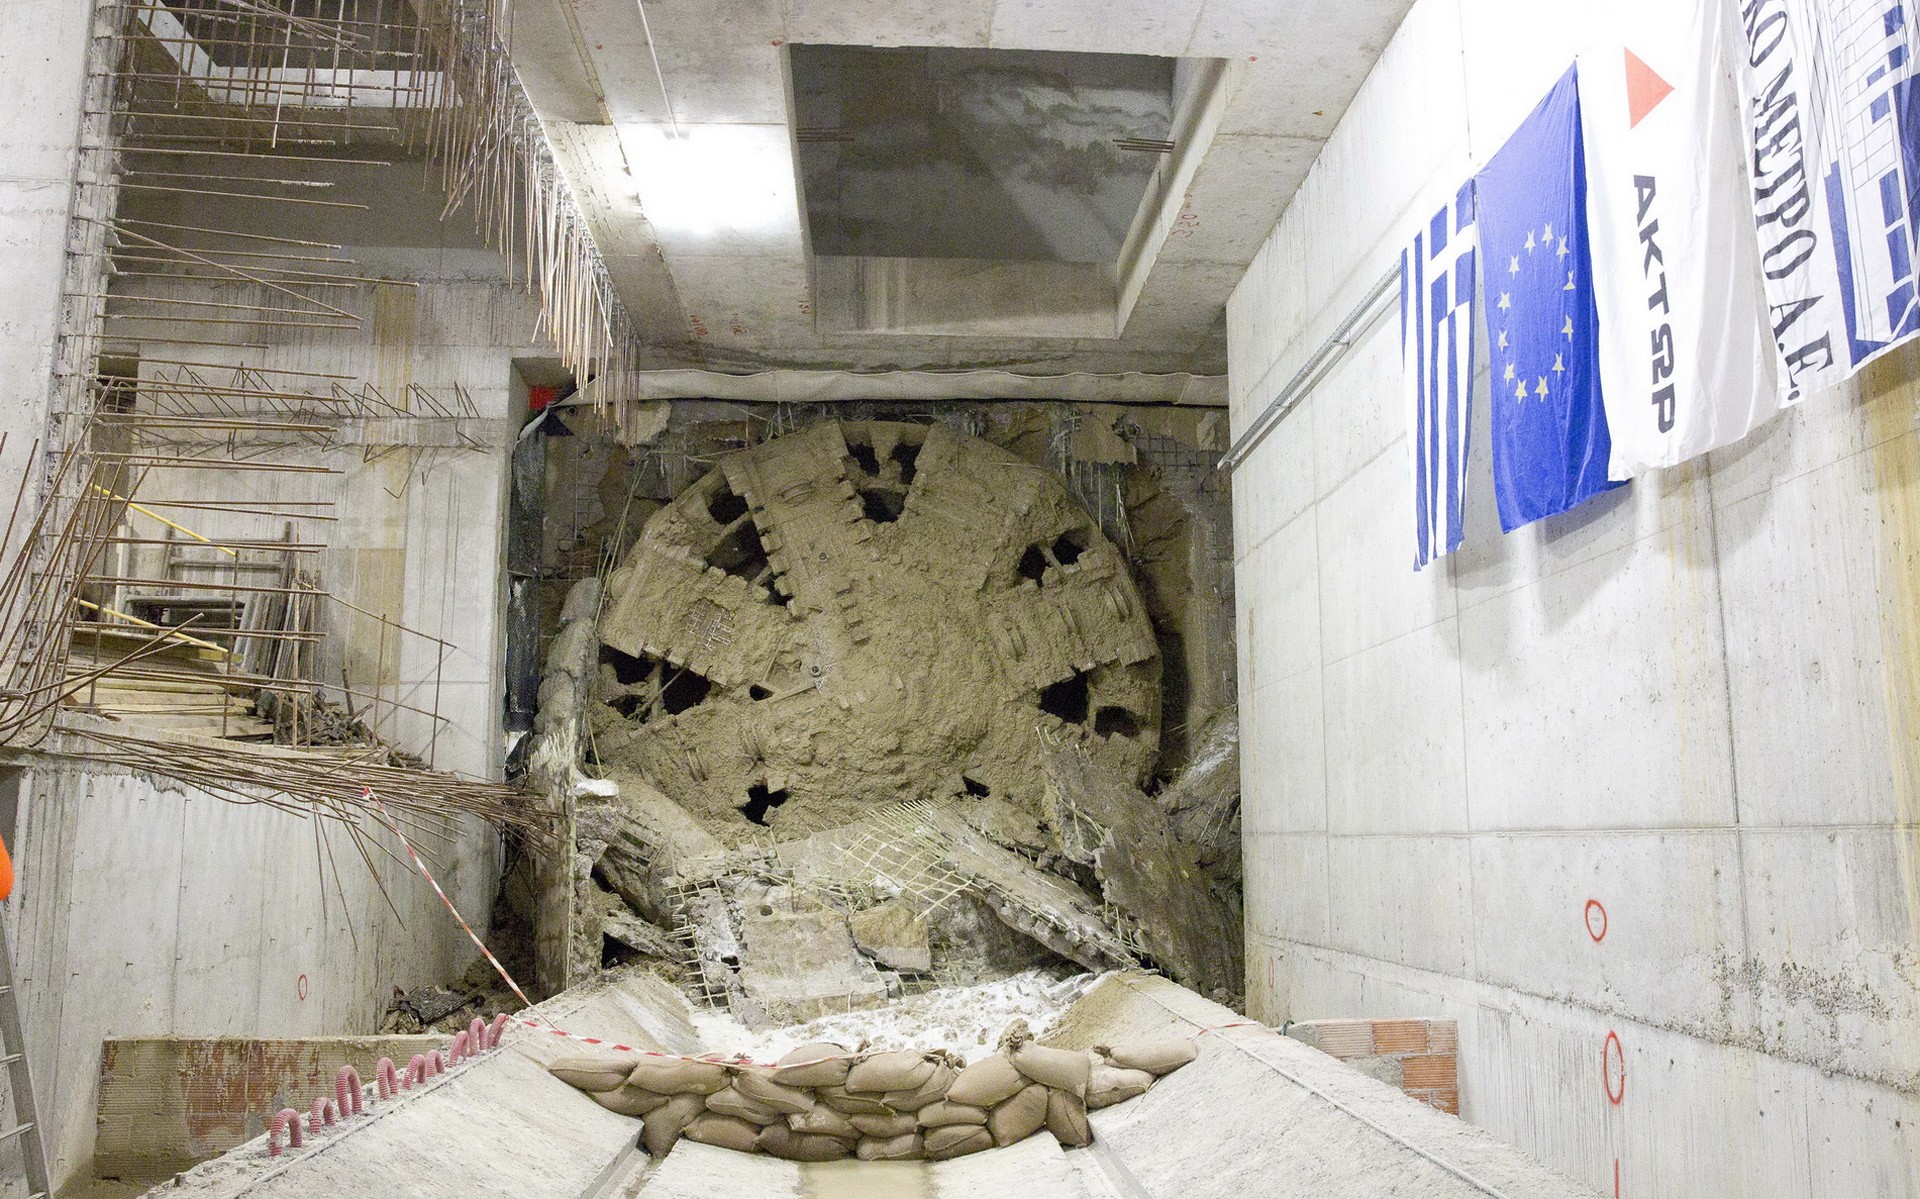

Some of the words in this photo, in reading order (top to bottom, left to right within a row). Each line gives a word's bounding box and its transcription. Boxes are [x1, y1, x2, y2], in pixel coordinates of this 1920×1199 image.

[1753, 57, 1818, 280] ΜΕΤΡΟ
[1633, 174, 1676, 434] ΑΚΤΩΡ
[1768, 295, 1834, 401] Α.Ε.
